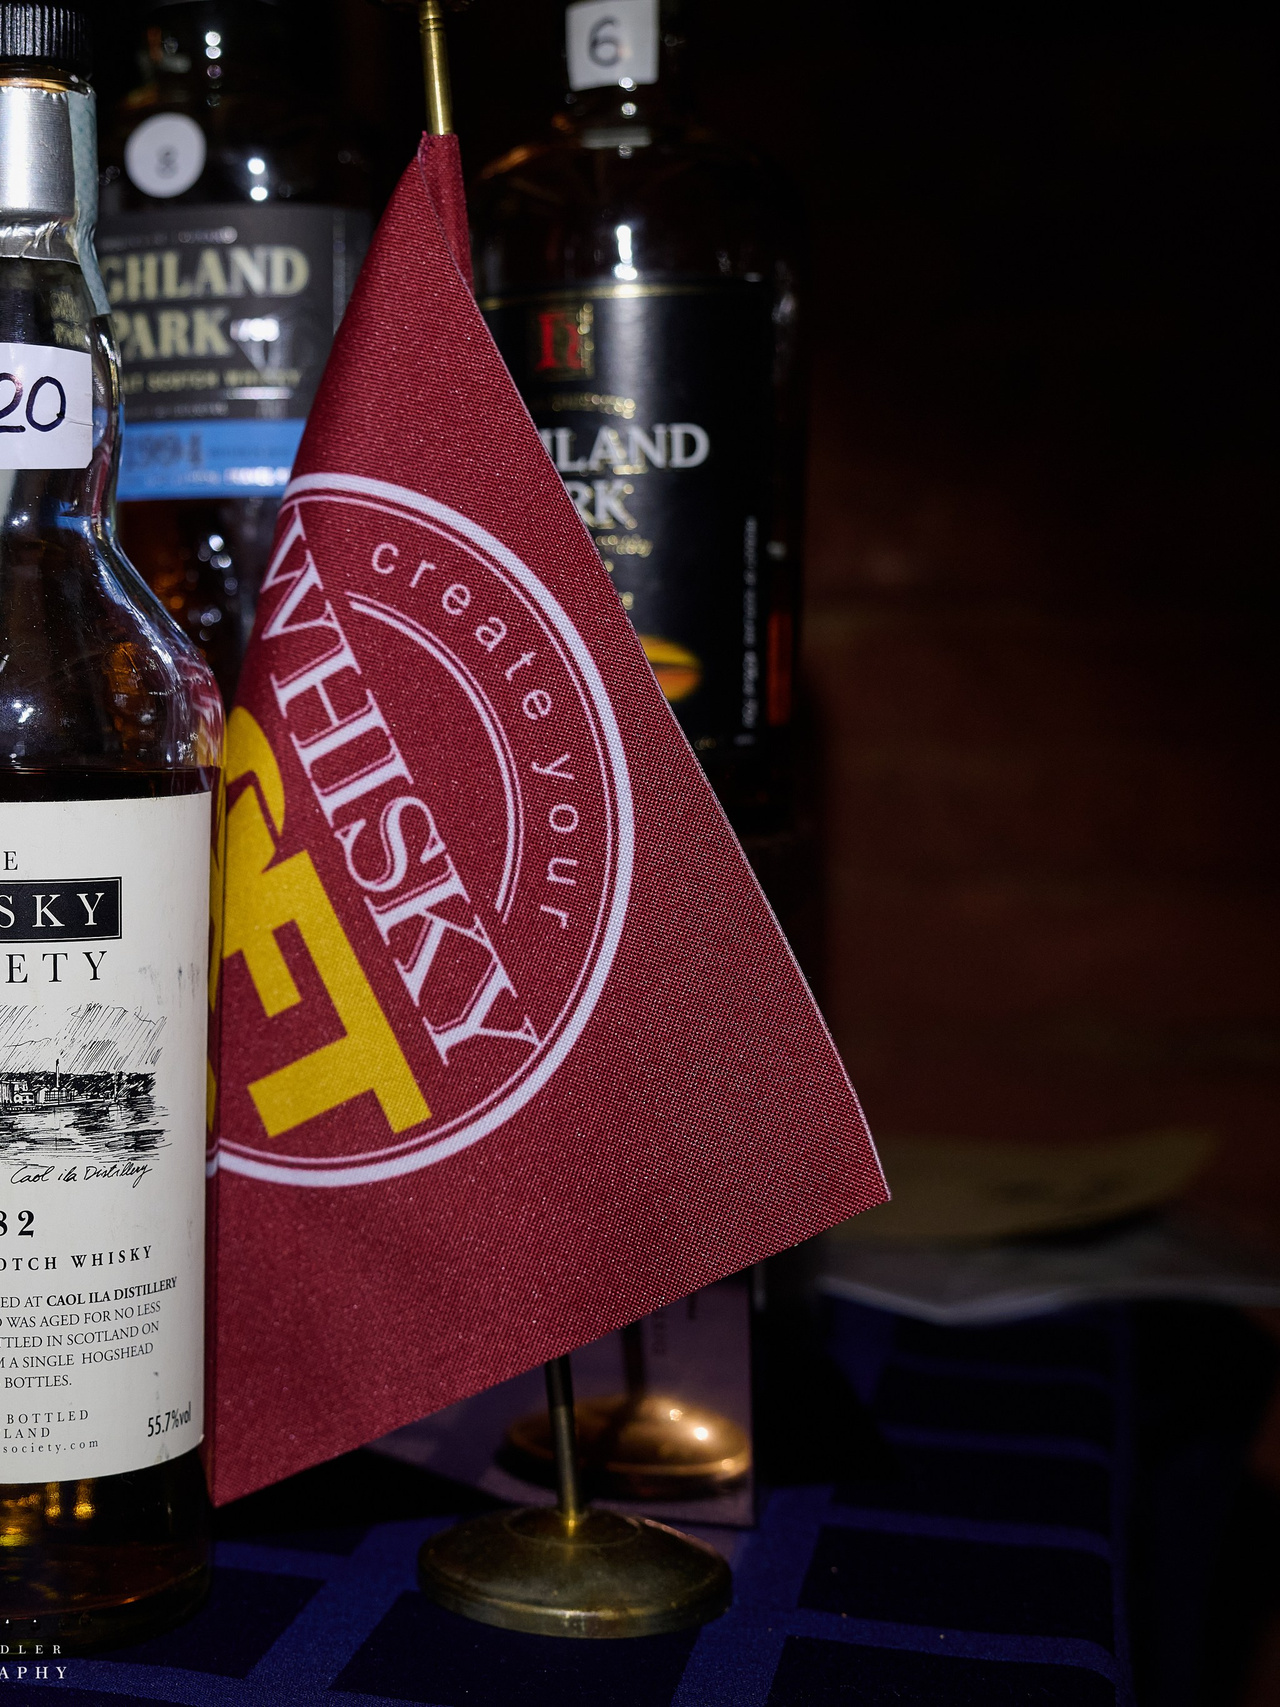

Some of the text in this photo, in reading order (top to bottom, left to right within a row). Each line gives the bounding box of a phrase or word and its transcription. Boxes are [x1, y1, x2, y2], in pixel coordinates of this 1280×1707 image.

[588, 16, 622, 68] 6
[371, 543, 552, 722] create
[261, 502, 541, 1067] WHISKY
[532, 755, 582, 930] your
[10, 1166, 55, 1184] Caol
[84, 1162, 153, 1188] Distillery
[71, 1245, 152, 1268] WHISKY
[24, 1295, 43, 1308] AT
[46, 1293, 86, 1307] CAOL
[89, 1290, 111, 1304] ILA
[114, 1275, 178, 1301] DISTILLERY
[6, 1316, 36, 1328] WAS
[40, 1313, 80, 1327] AGED
[83, 1310, 112, 1325] FOR
[114, 1306, 134, 1321] NO
[137, 1300, 161, 1317] LESS
[47, 1334, 63, 1347] IN
[66, 1325, 139, 1346] SCOTLAND
[141, 1321, 160, 1336] ON
[9, 1356, 19, 1369] A
[22, 1354, 75, 1369] SINGLE
[81, 1342, 154, 1365] HOGSHEAD
[4, 1374, 73, 1389] BOTTLES.
[6, 1409, 90, 1425] BOTTLED
